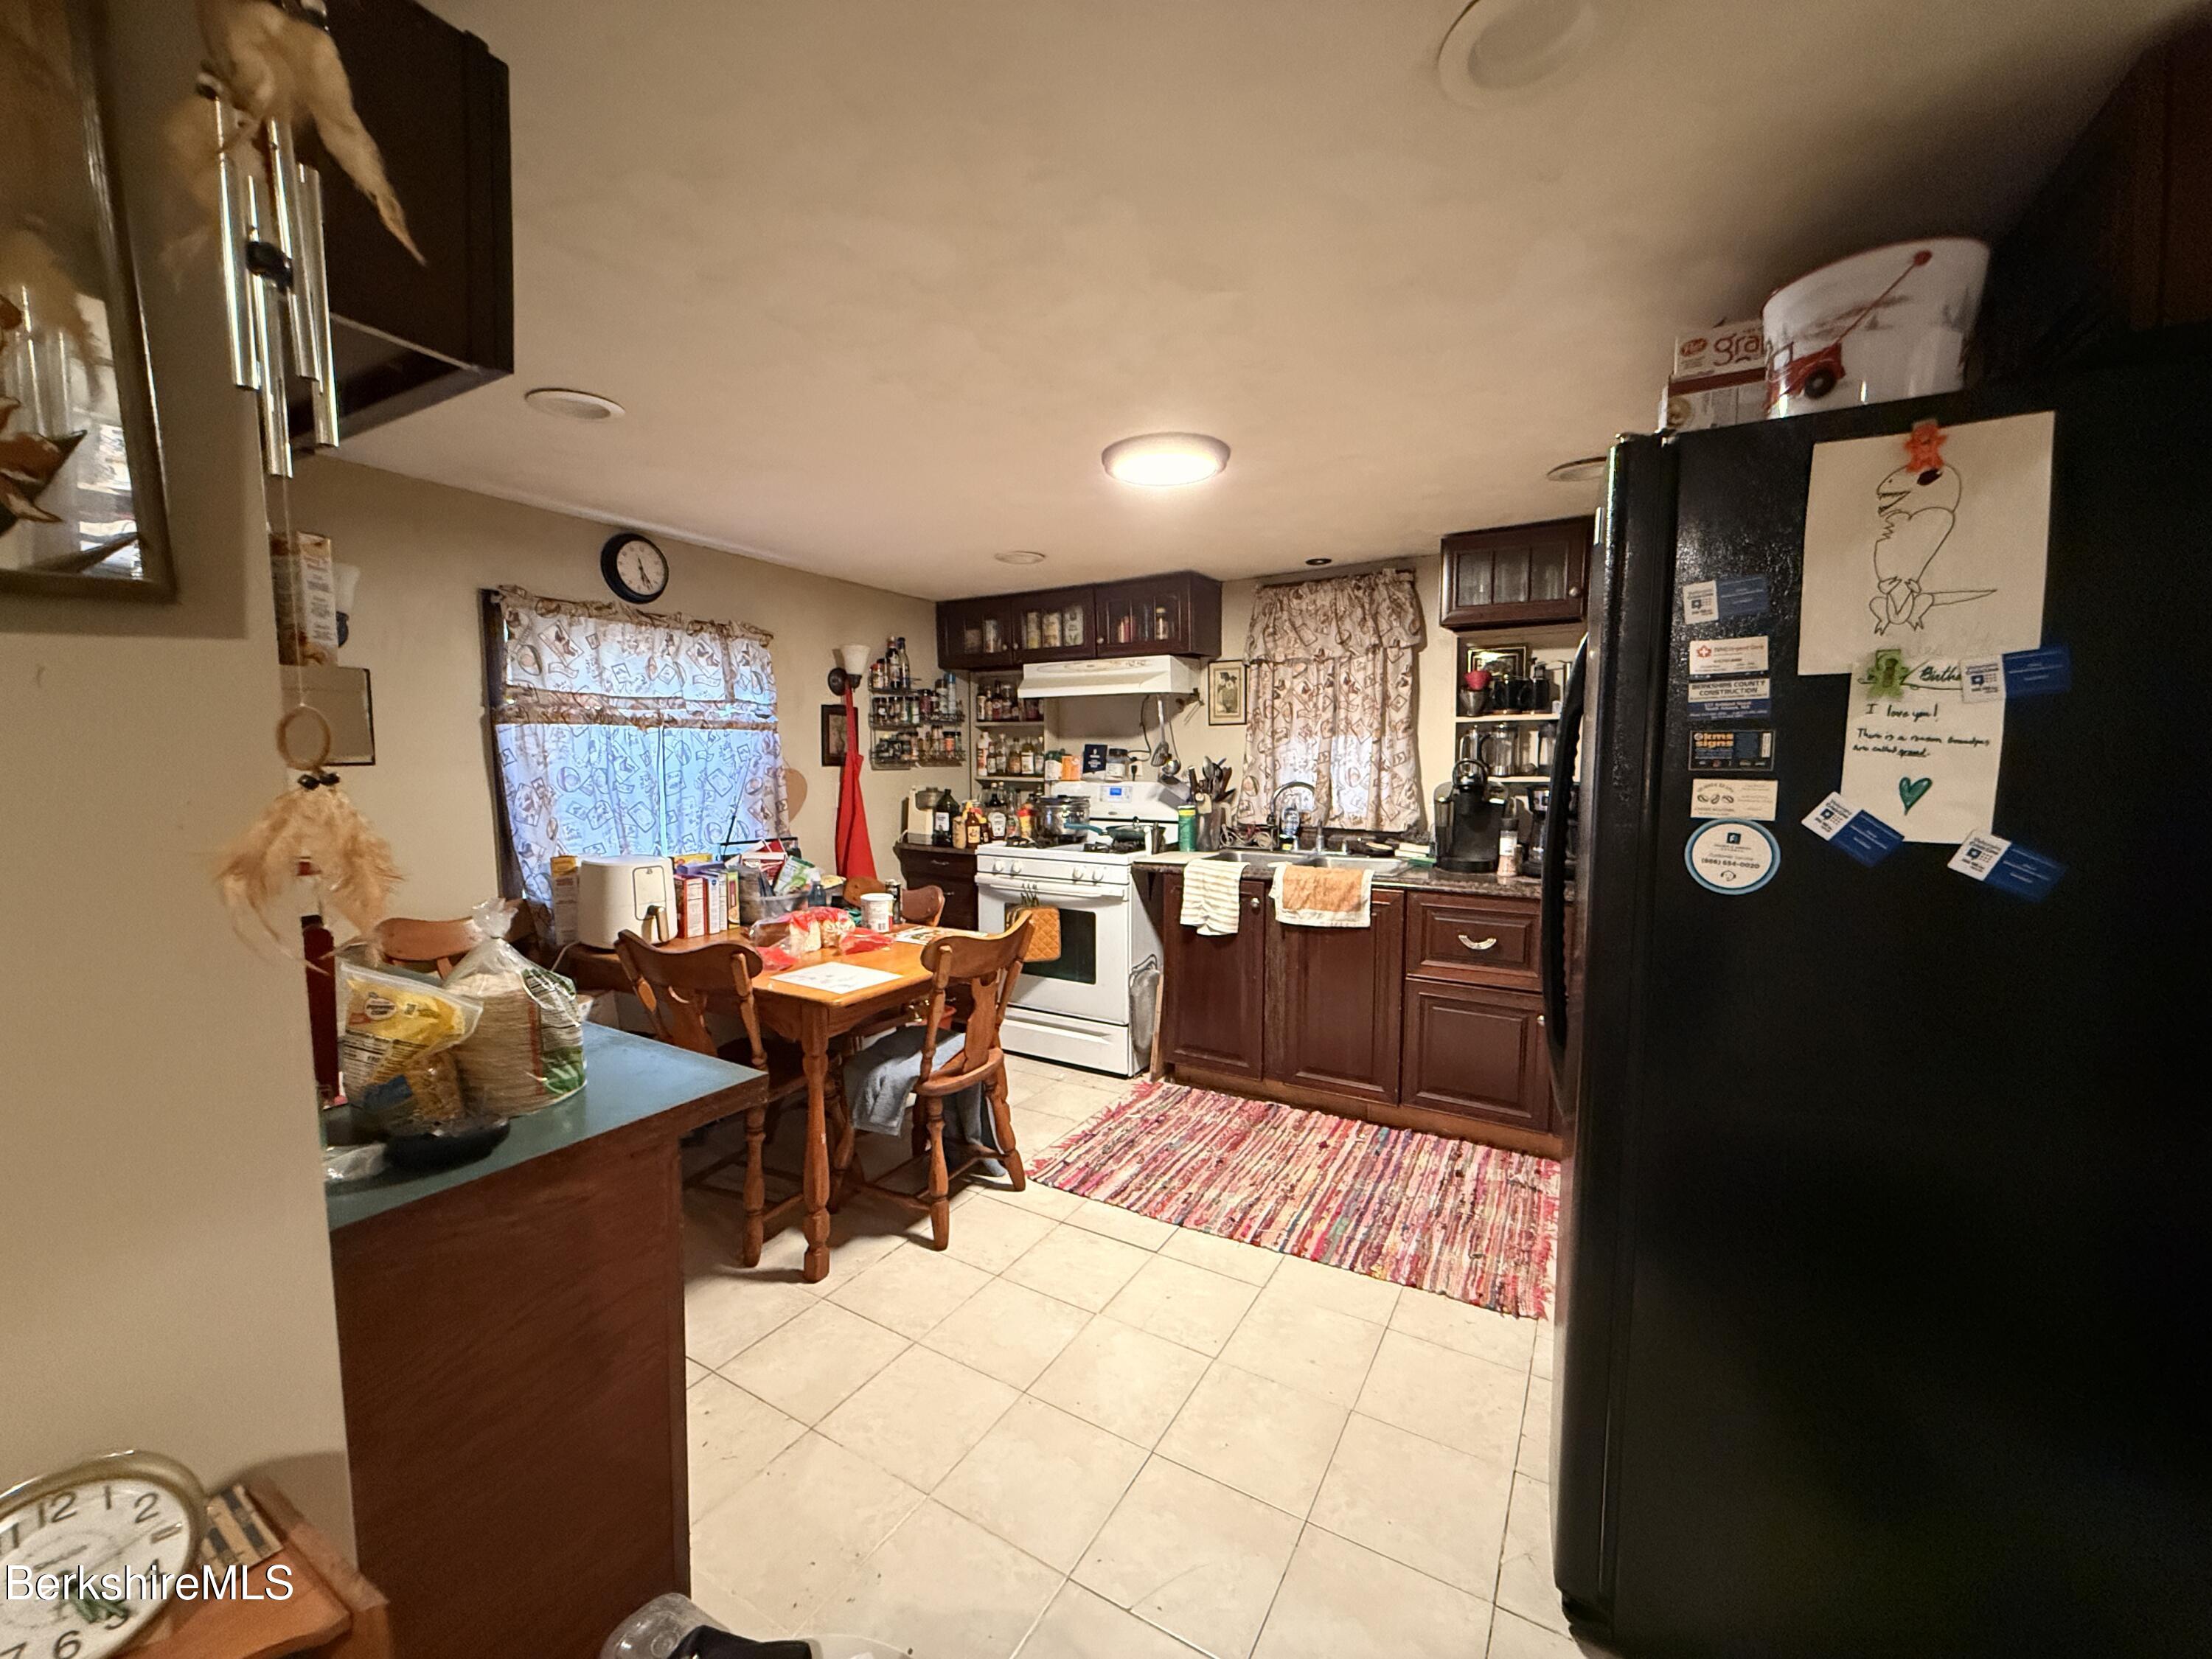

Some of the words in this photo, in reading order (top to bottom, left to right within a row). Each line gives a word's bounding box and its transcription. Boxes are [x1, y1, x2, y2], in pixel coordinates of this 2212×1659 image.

[1691, 682, 1732, 690] BERKSHIRE
[1733, 680, 1765, 688] COUNTY
[1699, 688, 1759, 696] CONSTRUCTION
[1865, 703, 1878, 714] I
[1887, 704, 1910, 717] love
[1703, 732, 1734, 740] kms
[1857, 728, 1882, 739] There
[1885, 731, 1893, 740] is
[1695, 740, 1734, 748] signs
[38, 1491, 77, 1528] 12
[134, 1492, 159, 1523] 2
[53, 1630, 81, 1659] 6
